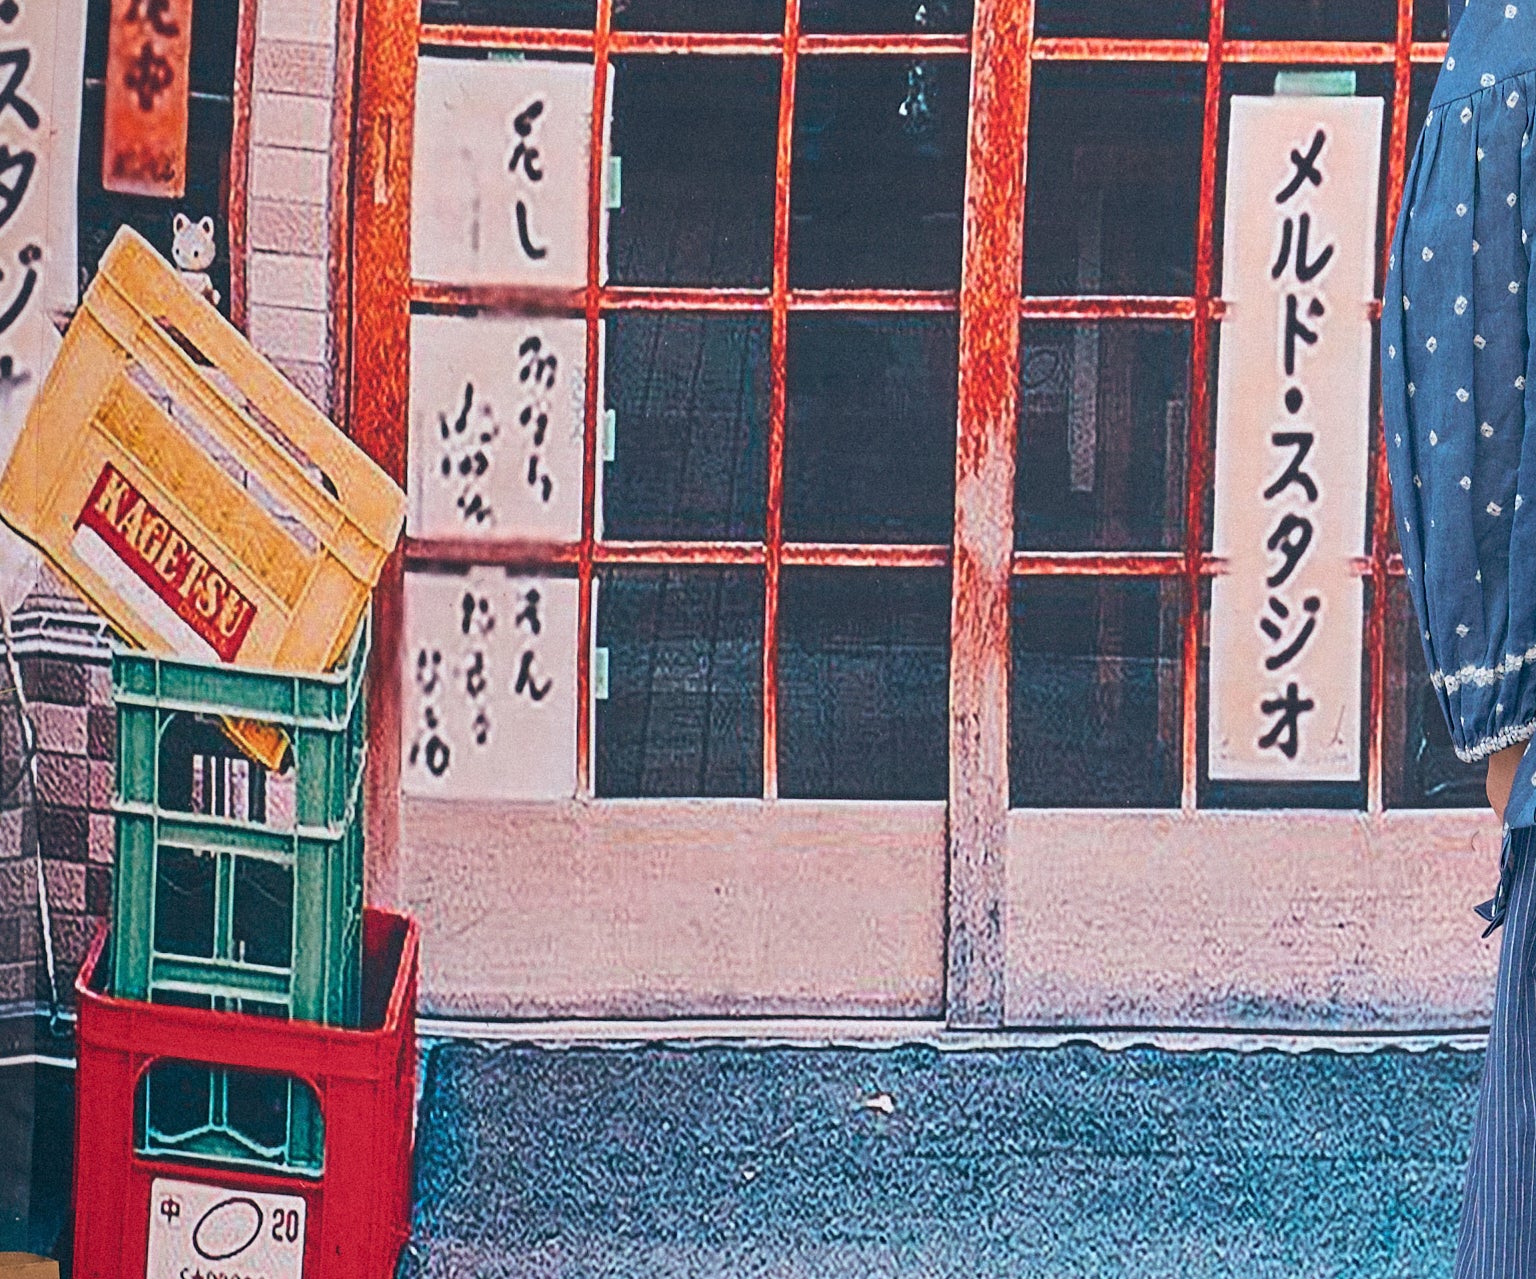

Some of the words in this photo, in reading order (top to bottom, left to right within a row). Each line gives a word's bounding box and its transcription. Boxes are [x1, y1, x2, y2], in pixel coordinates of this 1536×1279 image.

[1258, 128, 1334, 760] メルド・スタジオ
[161, 1194, 181, 1224] 中
[272, 1207, 299, 1244] 20
